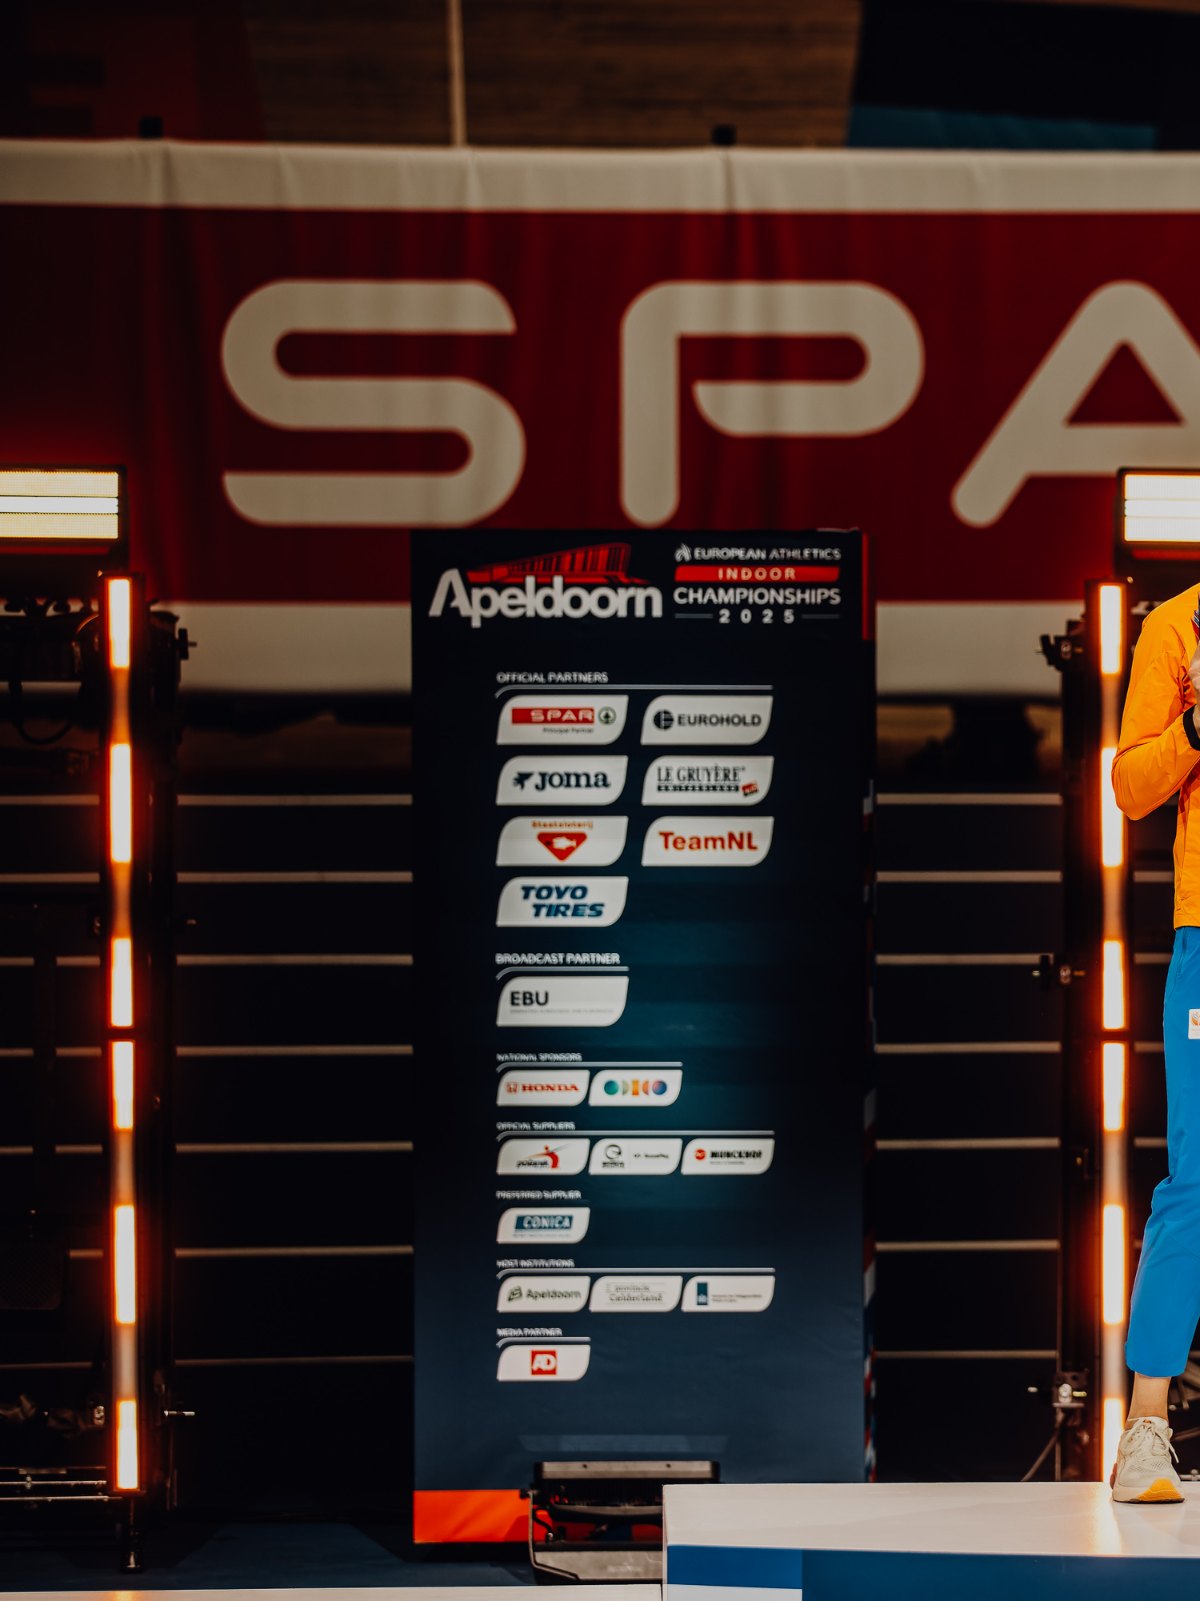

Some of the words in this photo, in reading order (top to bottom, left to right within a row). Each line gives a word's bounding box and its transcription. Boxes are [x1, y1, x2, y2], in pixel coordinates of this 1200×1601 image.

[694, 548, 766, 560] EUROPEAN
[768, 548, 841, 560] ATHLETICS
[717, 567, 797, 581] INDOOR
[428, 568, 663, 628] Apeldoorn
[673, 587, 841, 605] CHAMPIONSHIPS
[496, 672, 546, 684] OFFICIAL
[548, 672, 609, 684] PARTNERS
[530, 709, 594, 721] SPAR
[677, 713, 762, 728] EUROHOLD
[657, 767, 673, 782] LE
[659, 830, 760, 852] TeamNL
[520, 885, 589, 901] TOYO
[532, 902, 606, 918] TIRES
[495, 953, 565, 965] BROADCAST
[565, 953, 621, 965] PARTNER
[510, 991, 549, 1007] EBU
[521, 1083, 580, 1093] HONDA
[523, 1215, 571, 1229] CONICA
[526, 1287, 582, 1301] Apeldoorn
[533, 1353, 558, 1371] AD
